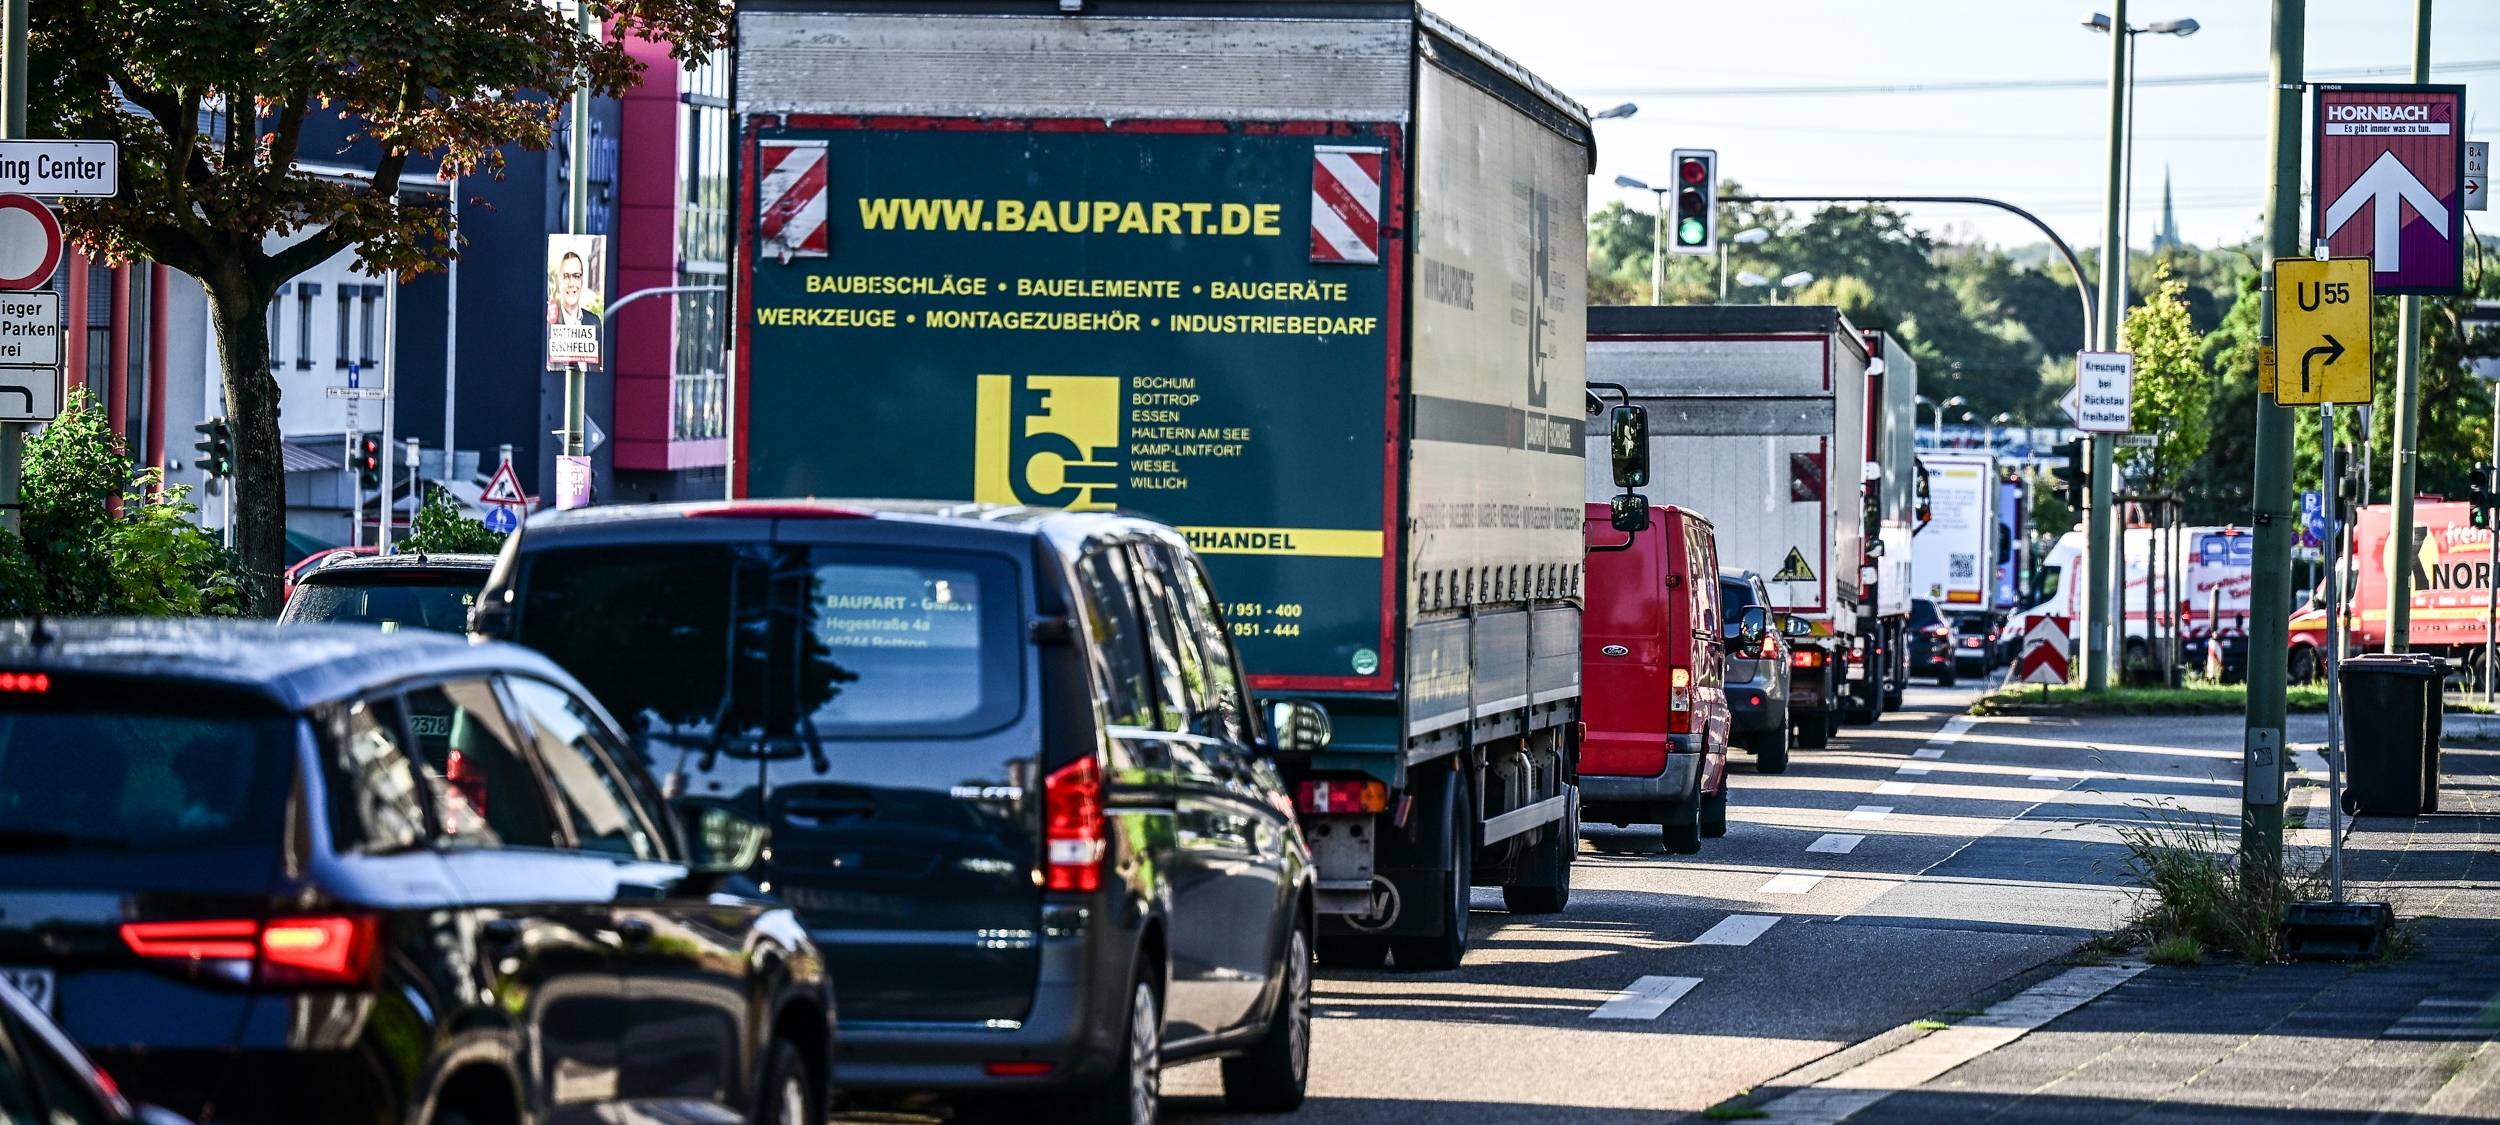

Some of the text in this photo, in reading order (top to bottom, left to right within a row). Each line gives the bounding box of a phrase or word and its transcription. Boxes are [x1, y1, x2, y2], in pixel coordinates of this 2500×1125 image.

[2328, 105, 2428, 121] HORNBACH
[2344, 124, 2432, 135] Es gibt immer was zu tun.
[0, 153, 106, 185] ing Center
[859, 198, 1281, 236] WWW.BAUPART.DE
[806, 275, 1347, 302] BAUBESCHLÄGE BAUELEMENTE BAUGERÄTE
[2, 300, 42, 319] ieger
[2, 320, 55, 336] Parken
[757, 307, 1377, 336] WERKZEUGE MONTAGEZUBEHÖR INDUSTRIEBEDARF
[1, 341, 21, 357] rei
[2085, 361, 2126, 374] Kreuzung
[1132, 376, 1196, 389] BOCHUM
[2098, 379, 2112, 389] bei
[1132, 393, 1200, 406] BOTTROP
[2084, 394, 2125, 406] Rückstau
[1131, 409, 1180, 422] ESSEN
[2083, 411, 2126, 422] freihalten
[1131, 427, 1250, 441] HALTERN AM SEE
[1130, 443, 1242, 457] KAMP-LINTFORT
[1130, 460, 1180, 473] WESEL
[1130, 477, 1188, 490] WILLICH
[1185, 531, 1297, 550] HHANDEL
[827, 594, 907, 610] BAUPART
[1236, 602, 1262, 617] 951
[1275, 603, 1303, 618] 400
[827, 617, 909, 632] Hegestraße
[1234, 622, 1260, 637] 951
[1273, 623, 1300, 637] 444
